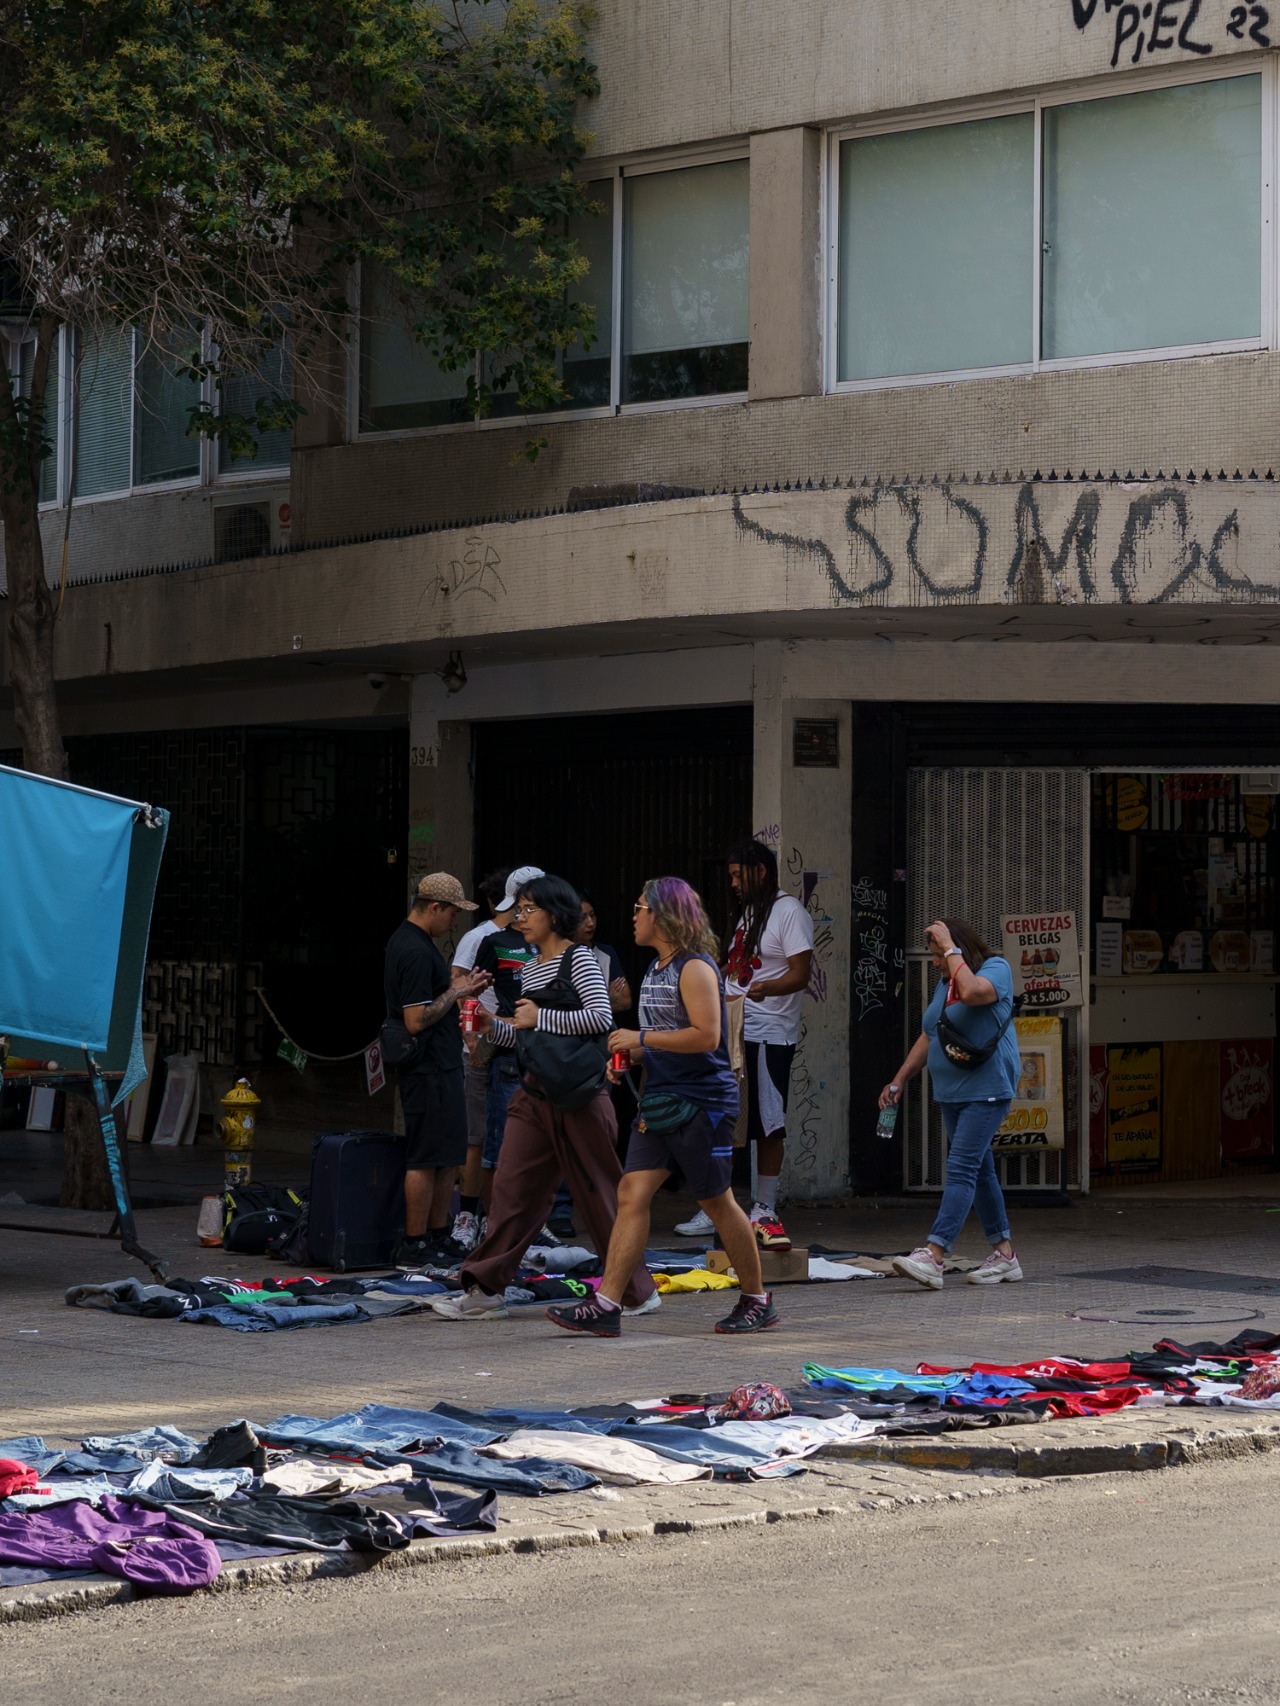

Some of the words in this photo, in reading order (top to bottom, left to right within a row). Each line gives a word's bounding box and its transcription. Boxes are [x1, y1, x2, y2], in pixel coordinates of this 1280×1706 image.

[411, 746, 435, 766] 394
[1005, 915, 1072, 934] CERVEZAS
[1018, 931, 1062, 946] BELGAS
[1024, 978, 1061, 992] oferta
[1023, 993, 1030, 1003] 3
[1039, 990, 1068, 1003] 5.000
[1236, 1078, 1266, 1101] break
[991, 1132, 1048, 1146] FERTA
[1112, 1132, 1124, 1143] TE
